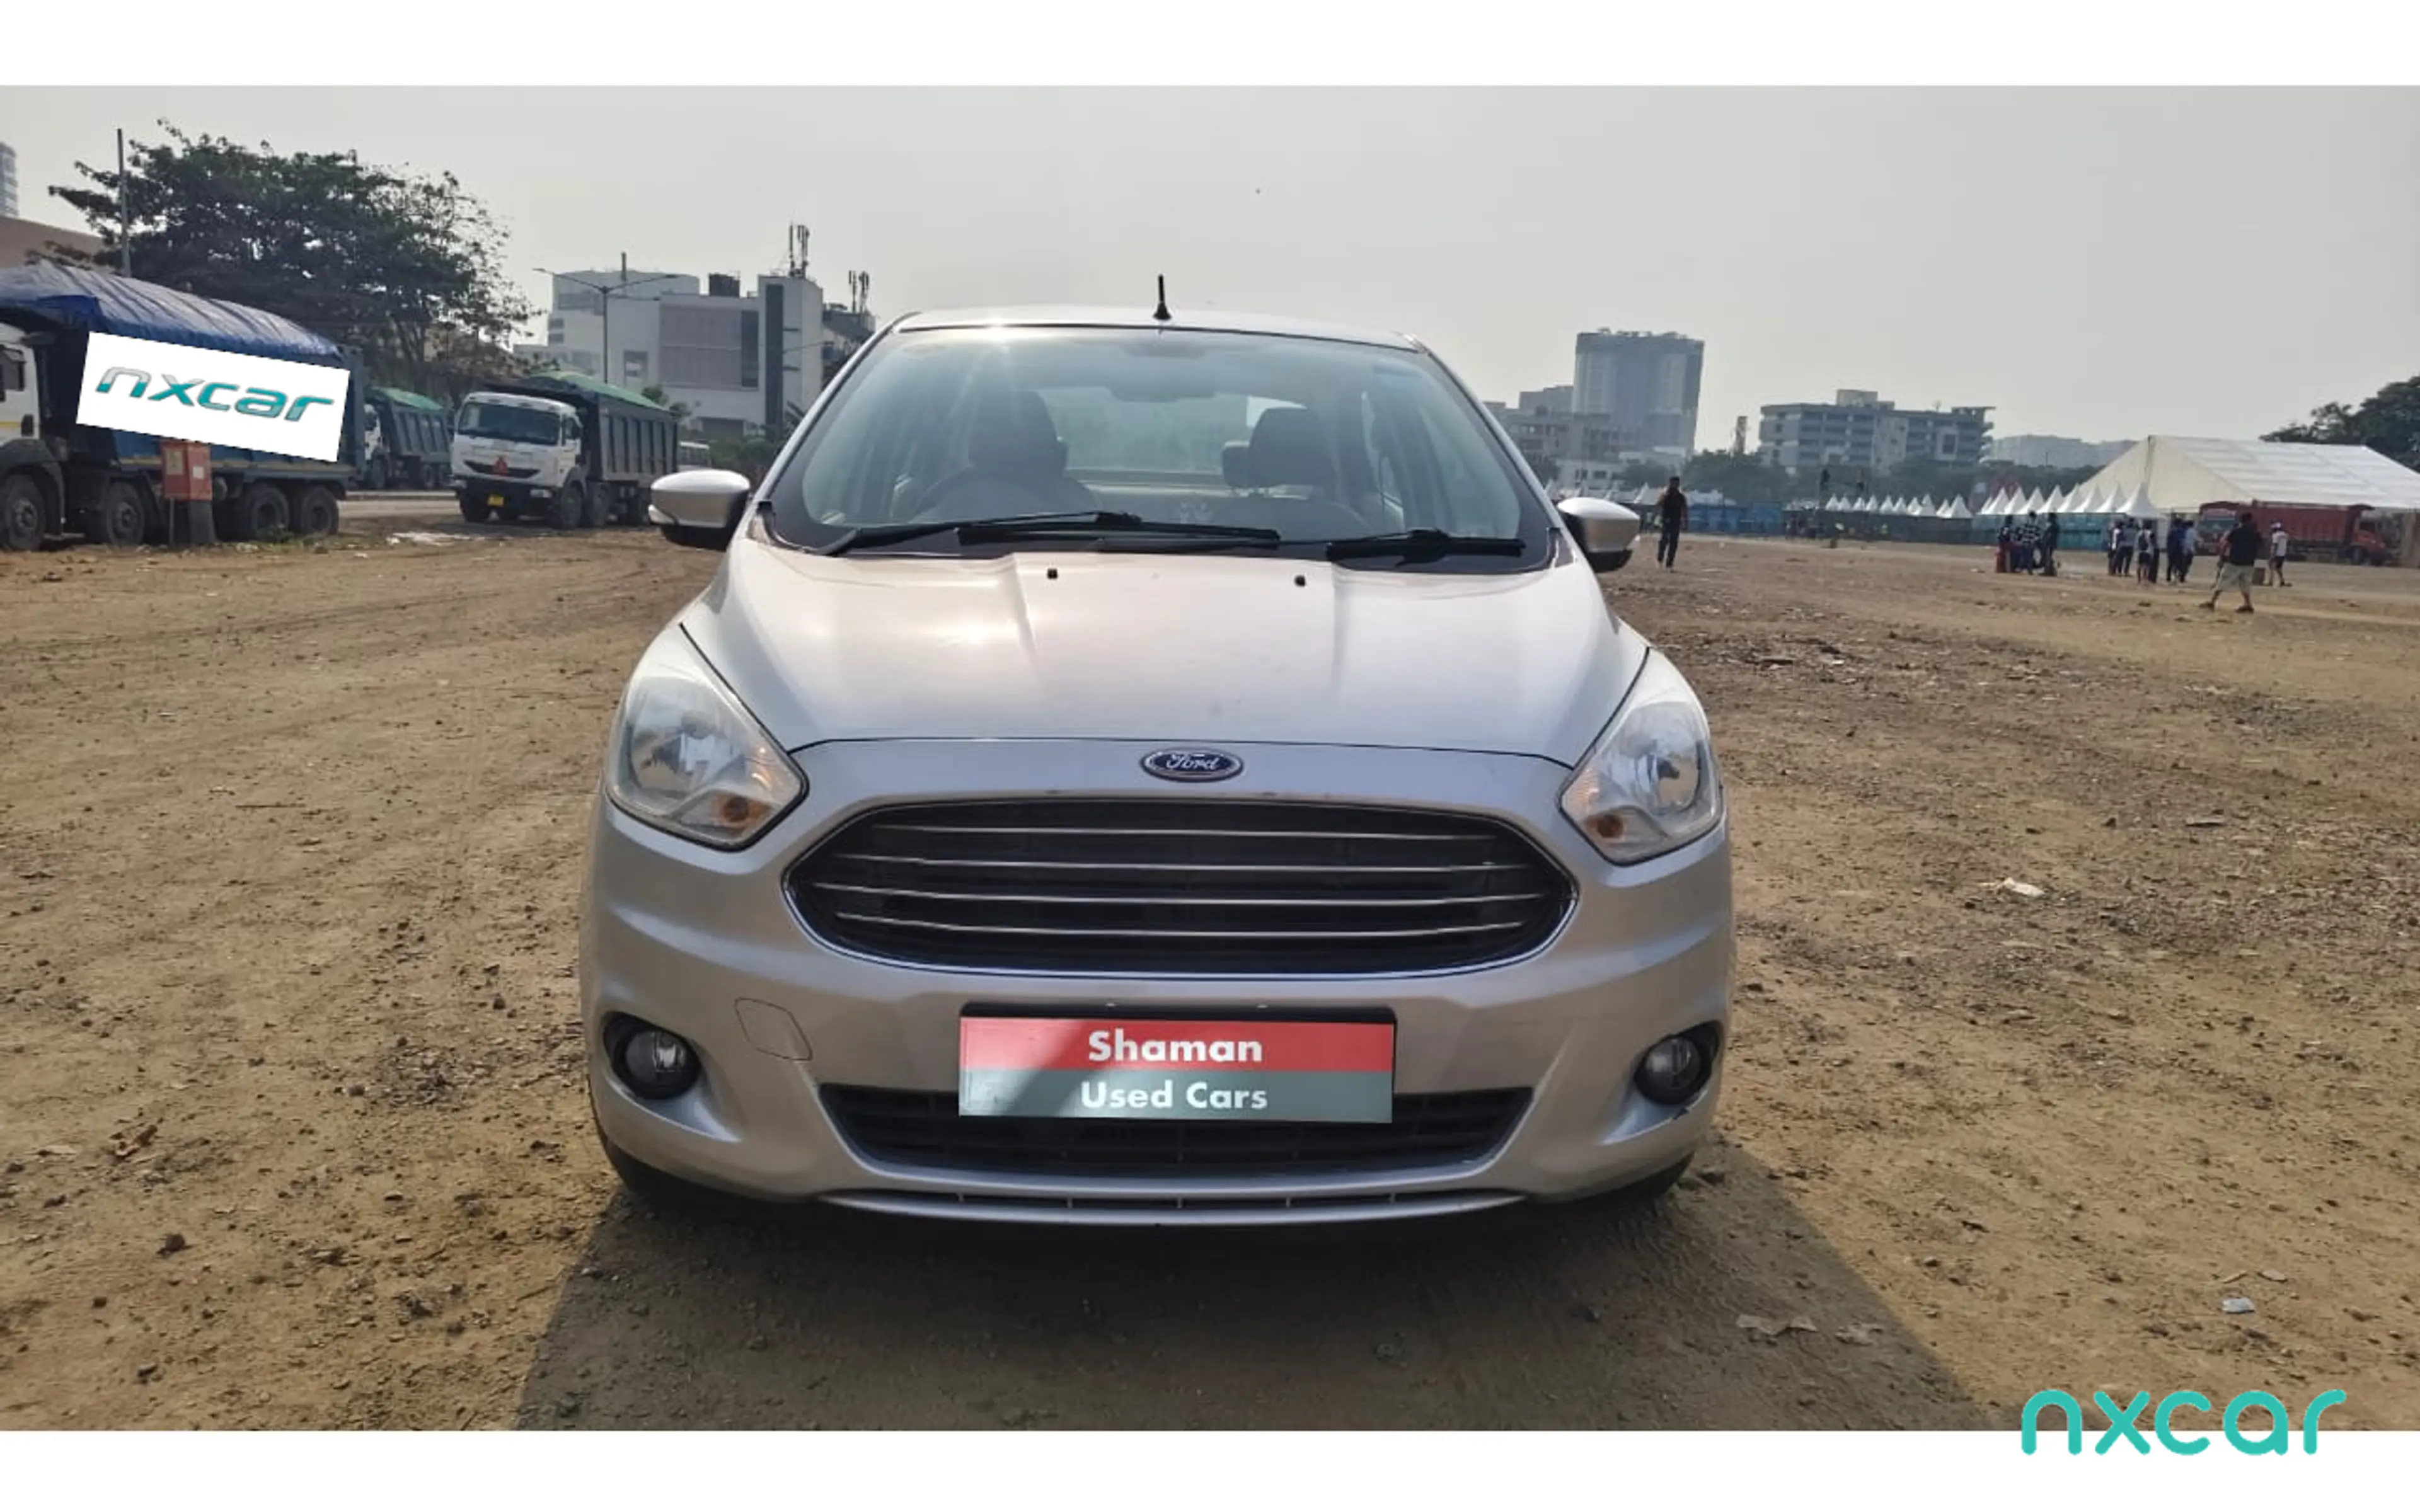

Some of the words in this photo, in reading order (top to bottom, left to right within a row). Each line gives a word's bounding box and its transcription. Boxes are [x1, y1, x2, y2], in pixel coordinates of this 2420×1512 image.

[1166, 753, 1219, 770] Ford
[1088, 1028, 1263, 1063] Shaman
[1081, 1080, 1173, 1109] Used
[1185, 1082, 1269, 1109] Cars
